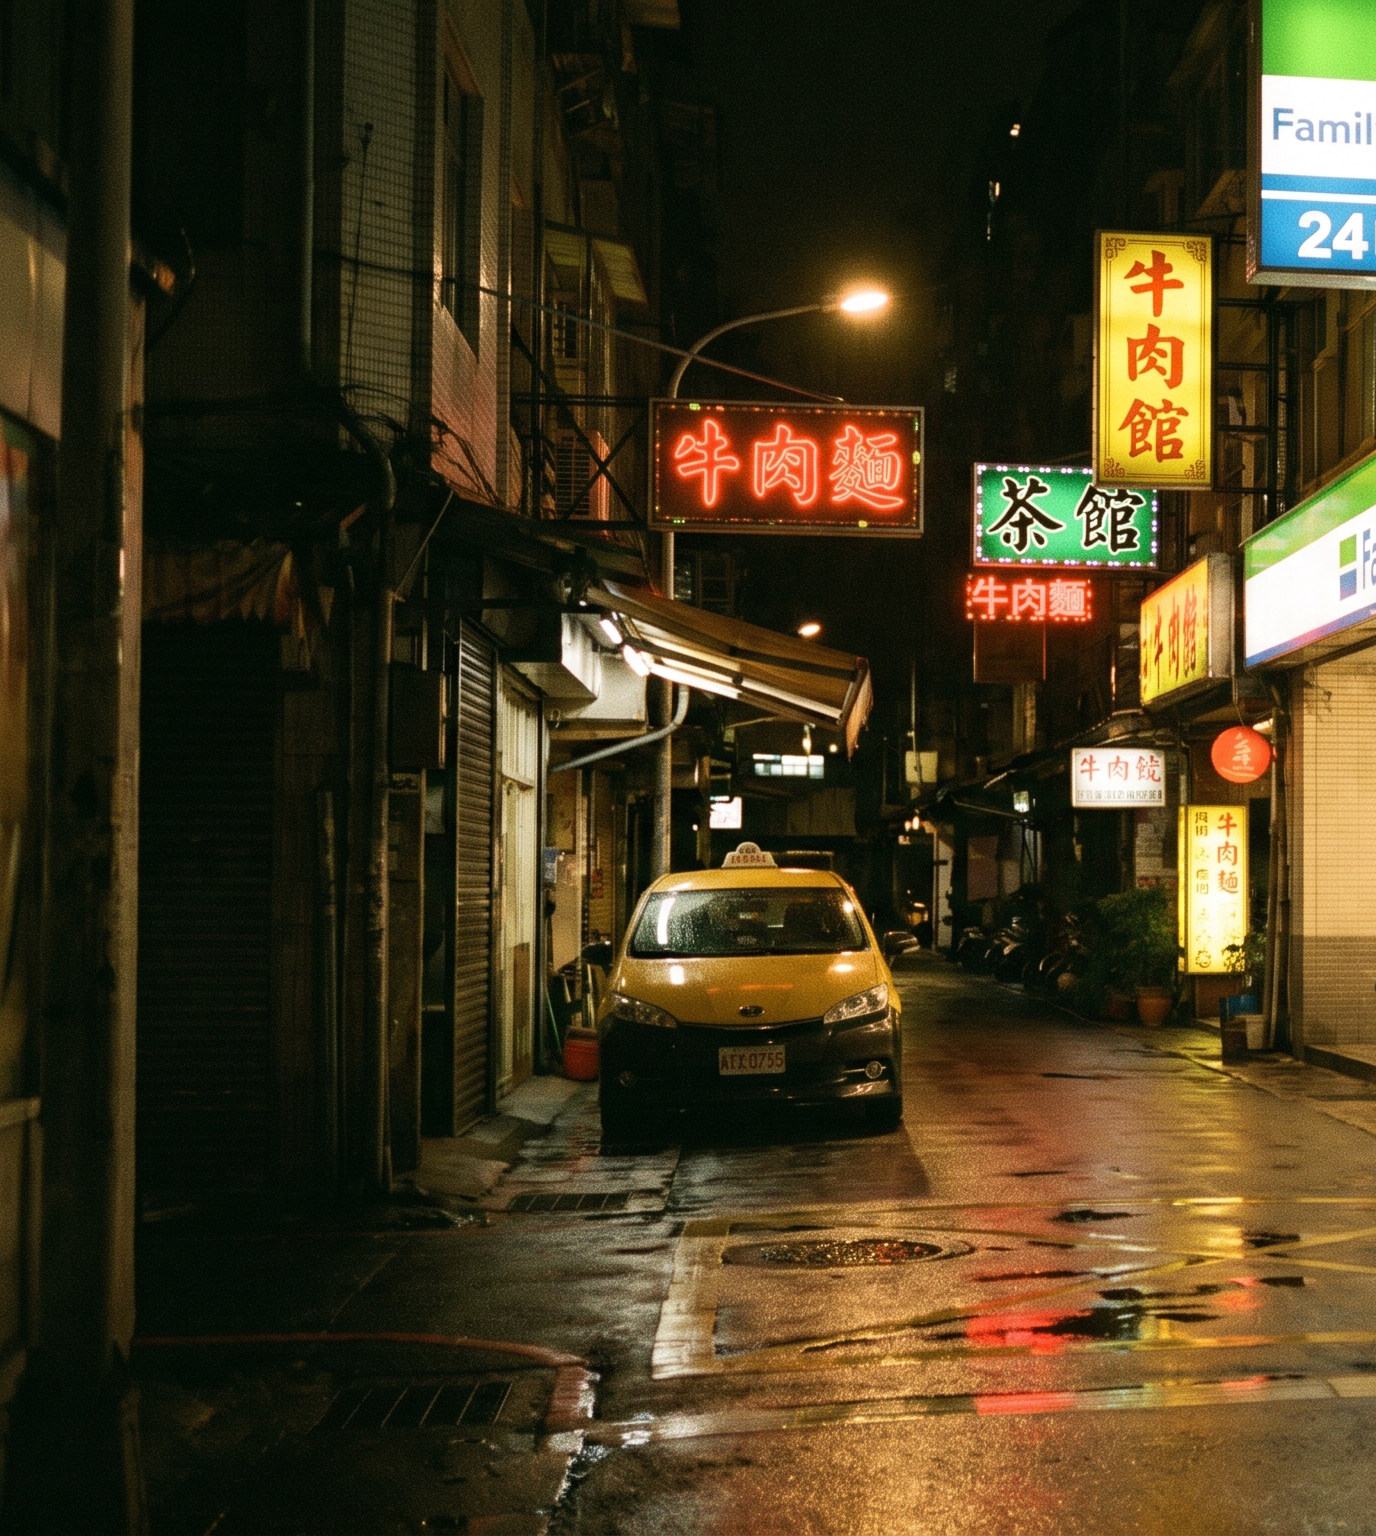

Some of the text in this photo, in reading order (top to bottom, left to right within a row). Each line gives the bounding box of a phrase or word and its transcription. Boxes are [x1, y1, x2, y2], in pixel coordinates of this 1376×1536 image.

[1118, 250, 1189, 463] 牛肉館
[675, 419, 904, 509] 牛肉麵
[987, 477, 1146, 554] 茶館
[972, 576, 1086, 616] 牛肉麵
